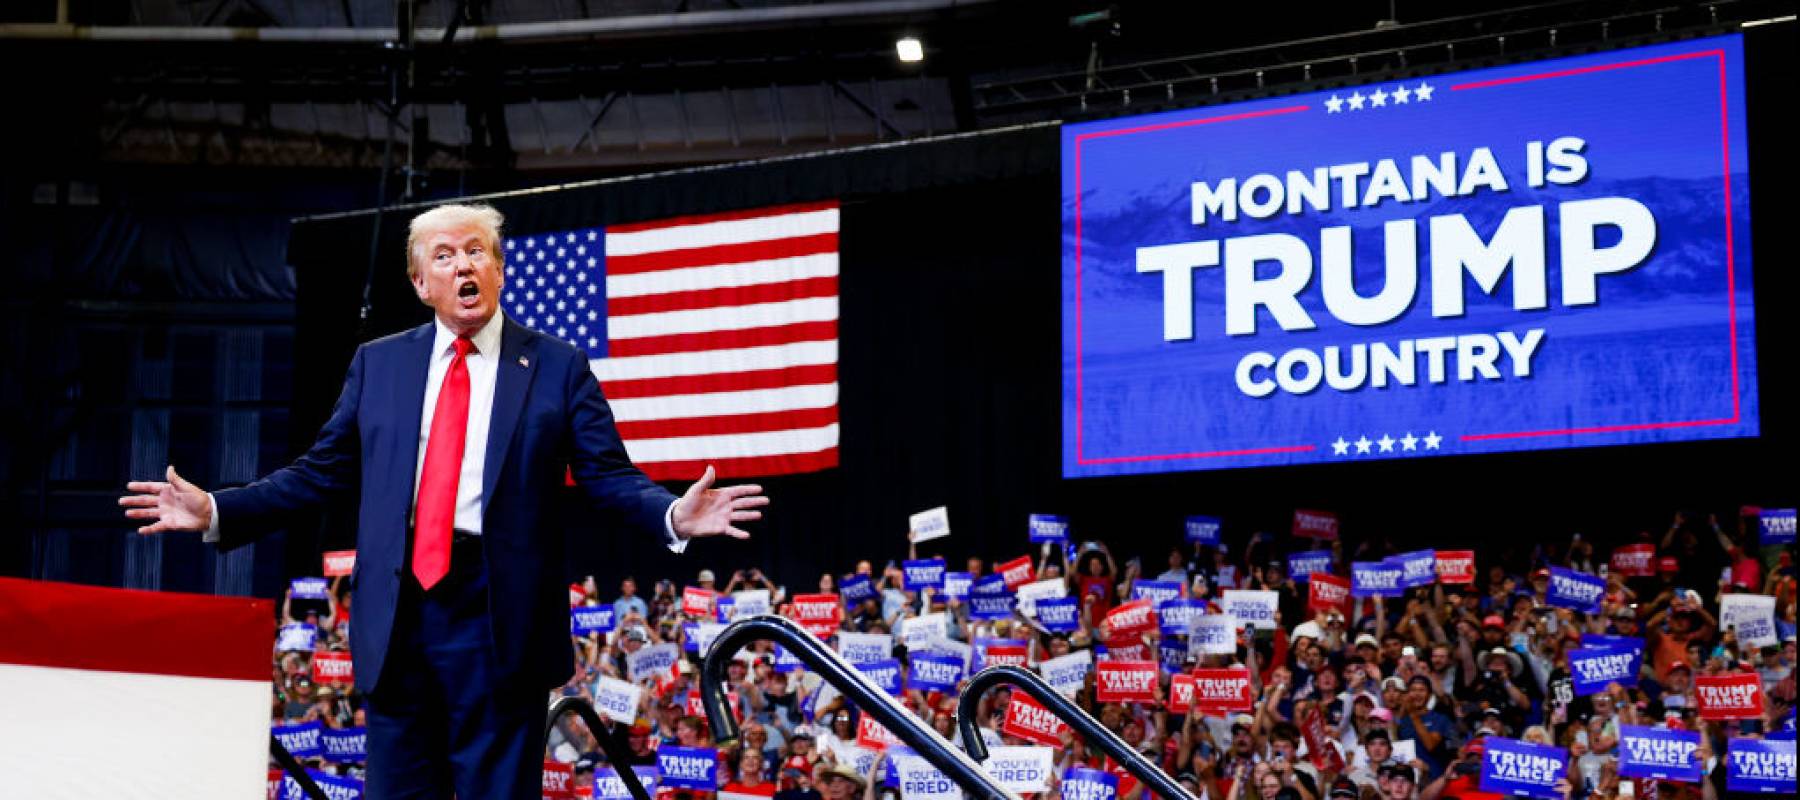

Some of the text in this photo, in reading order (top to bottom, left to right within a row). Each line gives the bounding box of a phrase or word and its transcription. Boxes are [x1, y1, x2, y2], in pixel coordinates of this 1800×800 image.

[1190, 136, 1588, 224] MONTANA IS
[1136, 197, 1657, 342] TRUMP
[1235, 329, 1546, 398] COUNTRY
[1762, 517, 1796, 527] TRU
[906, 566, 945, 575] TRUMP
[1354, 569, 1402, 580] TRUMP
[1313, 581, 1349, 596] TRUMP
[1358, 577, 1398, 588] VANCE
[1553, 575, 1603, 595] TRUMP
[1135, 586, 1179, 598] TRUMP
[1556, 584, 1597, 602] VANCE
[575, 611, 613, 622] TRUMP
[1039, 605, 1077, 614] TRUMP
[1161, 607, 1205, 617] TRUMP
[913, 659, 962, 671] TRUMP
[987, 655, 1025, 666] TRUMP
[1573, 652, 1634, 672] TRUMP
[917, 668, 955, 681] VANCE
[1100, 670, 1154, 681] TRUMP
[1583, 663, 1630, 681] VANCE
[1106, 679, 1149, 690] VANCE
[1196, 678, 1248, 689] TRUMP
[1698, 683, 1758, 698] TRUMP
[1202, 687, 1242, 699] VANCE
[1704, 694, 1754, 707] VANCE
[1016, 713, 1058, 736] VANCE
[322, 734, 367, 746] TRUMP
[1624, 737, 1697, 754] TRUMP
[660, 755, 714, 769] TRUMP
[1488, 750, 1562, 771] TRUMP
[1632, 749, 1688, 765] VANCE
[1732, 751, 1796, 766] TRUM
[666, 764, 708, 778] VANCE
[993, 760, 1041, 769] YOU'RE
[1495, 763, 1554, 782] VANCE
[904, 780, 955, 794] FIRED!
[1061, 779, 1116, 796] TRUMP
